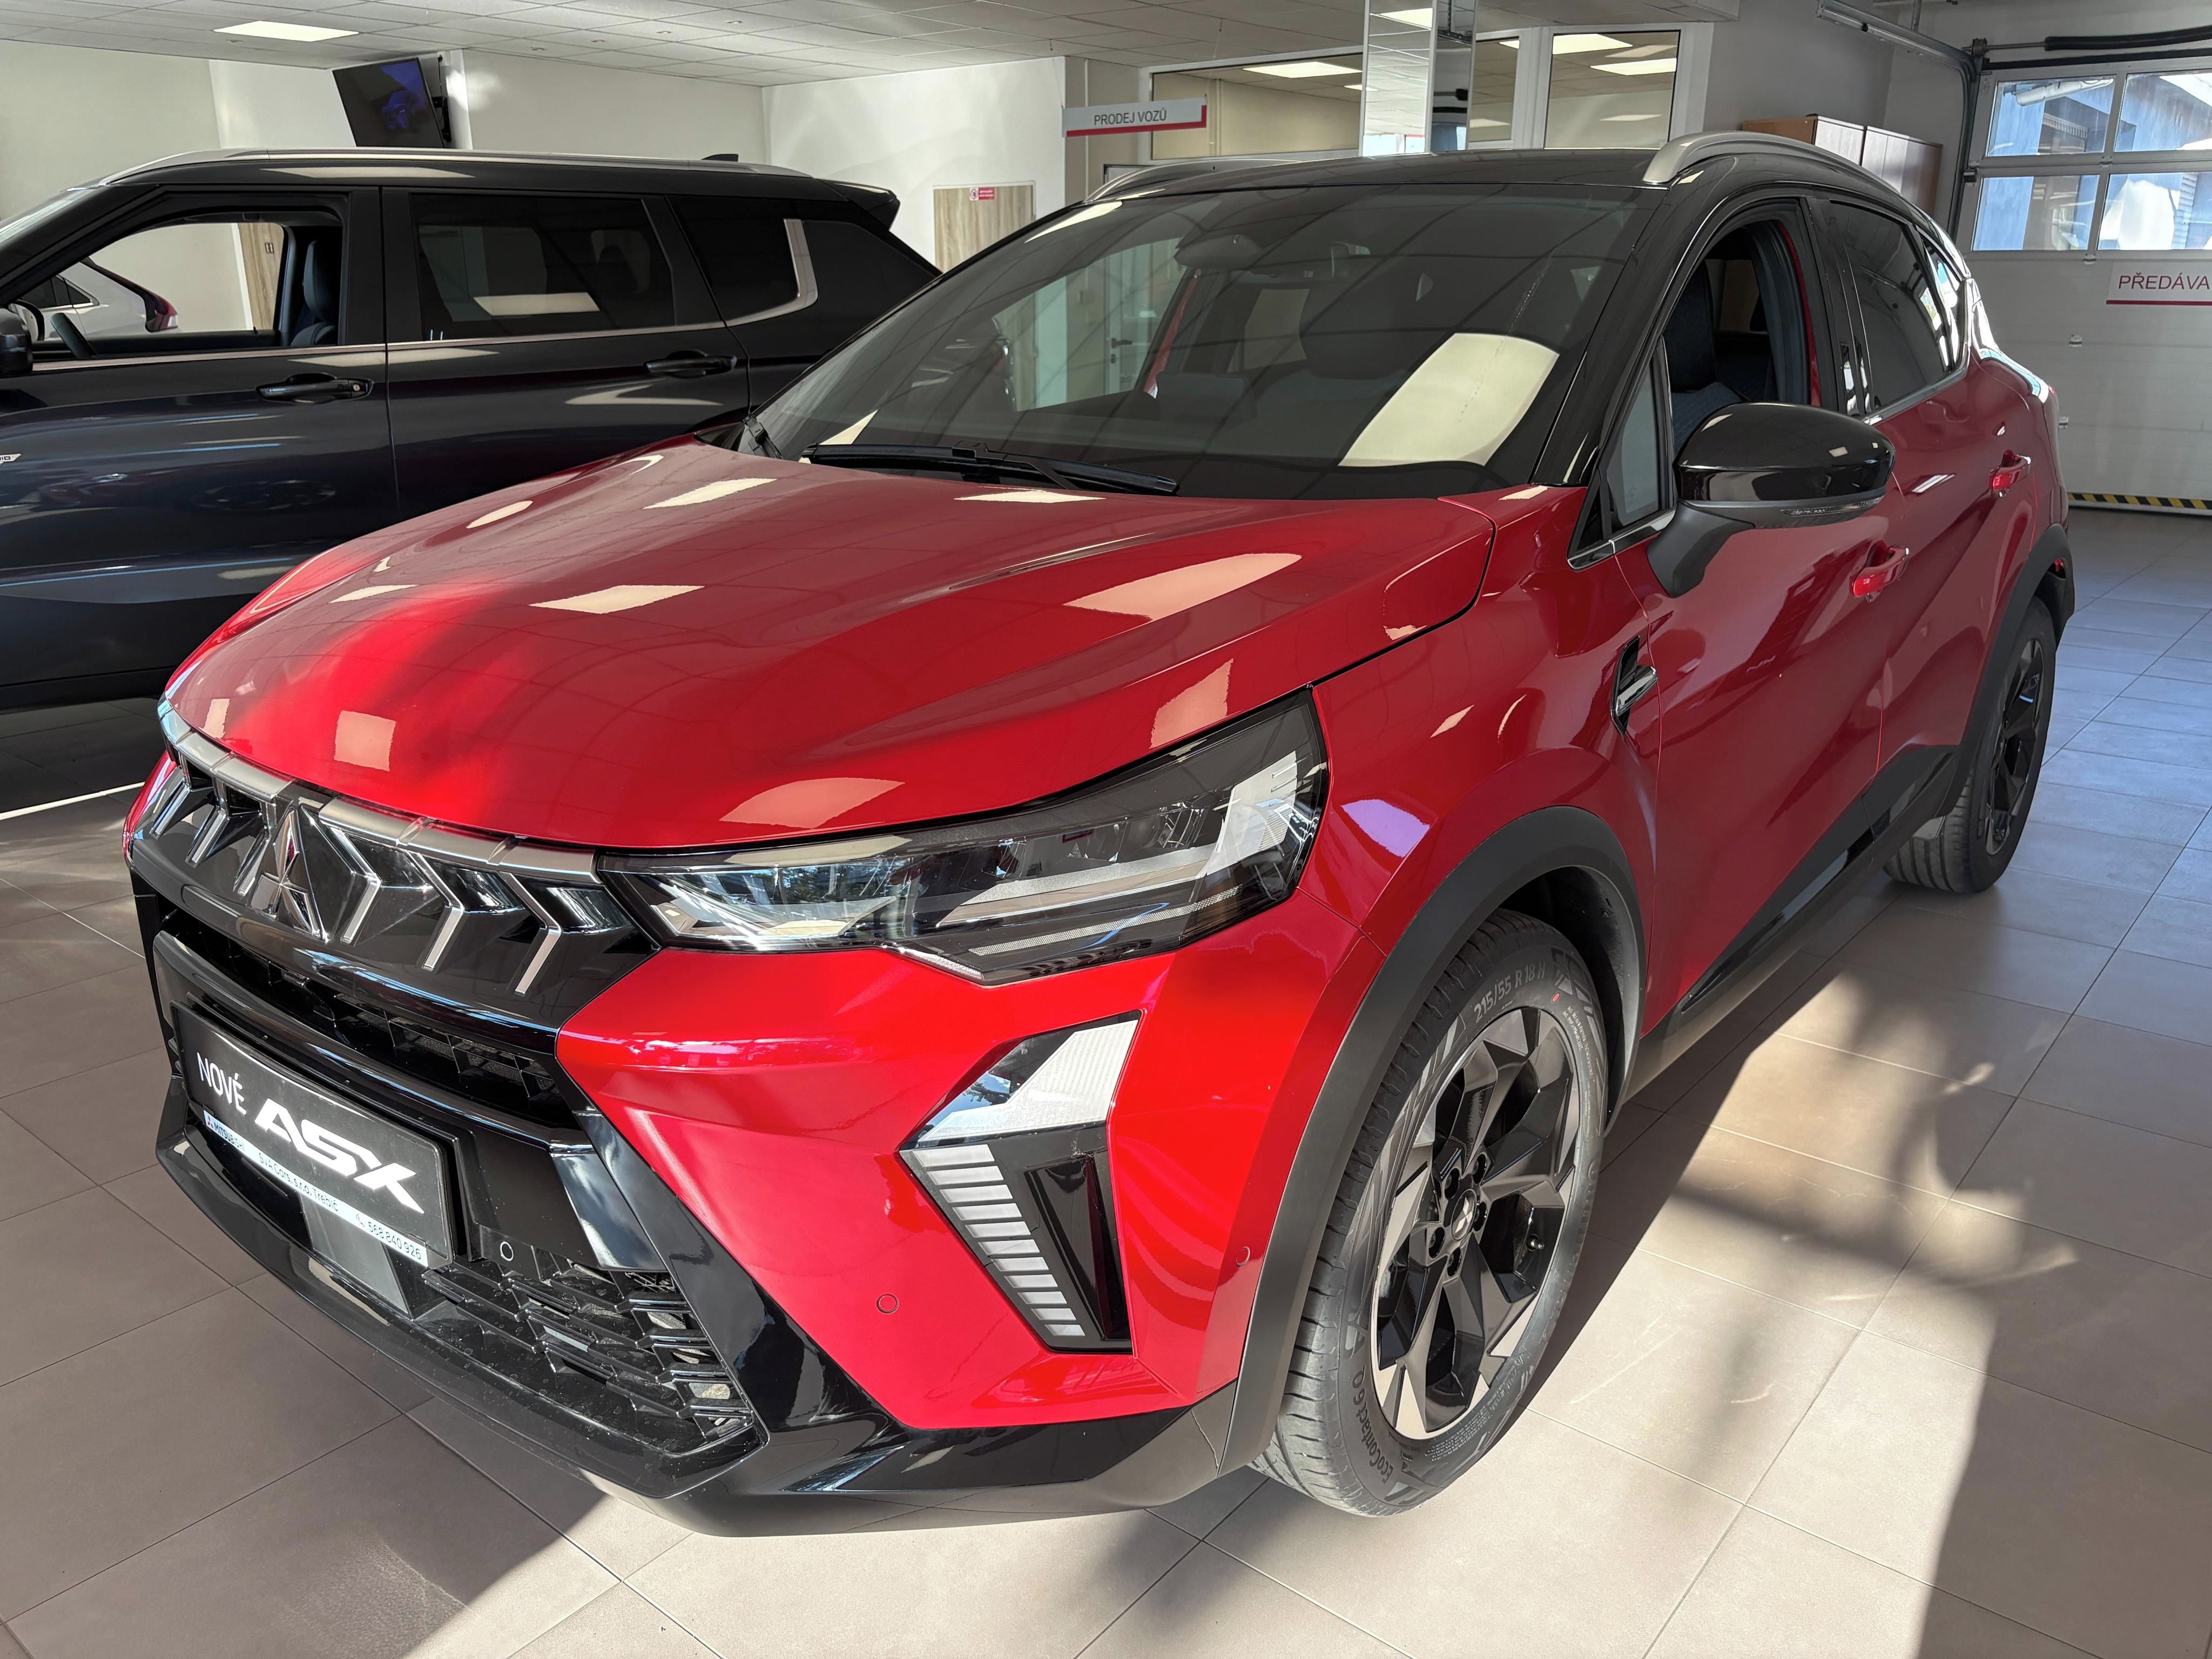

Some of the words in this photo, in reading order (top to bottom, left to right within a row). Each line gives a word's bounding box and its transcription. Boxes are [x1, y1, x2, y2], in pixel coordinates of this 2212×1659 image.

[1094, 112, 1135, 126] PRODEJ
[1137, 107, 1167, 123] VOZŮ
[2118, 272, 2212, 289] PŘEDÁVA
[1474, 974, 1512, 1023] 215/55
[1515, 969, 1522, 989] R
[1525, 963, 1535, 983] 18
[197, 1052, 247, 1116] NOVÉ
[255, 1098, 424, 1214] ASX
[214, 1122, 245, 1151] MITSUBISHI
[368, 1221, 384, 1239] 568
[386, 1231, 402, 1250] 840
[404, 1242, 421, 1260] 926
[1353, 1390, 1366, 1405] 6
[1356, 1401, 1394, 1484] EcoContact
